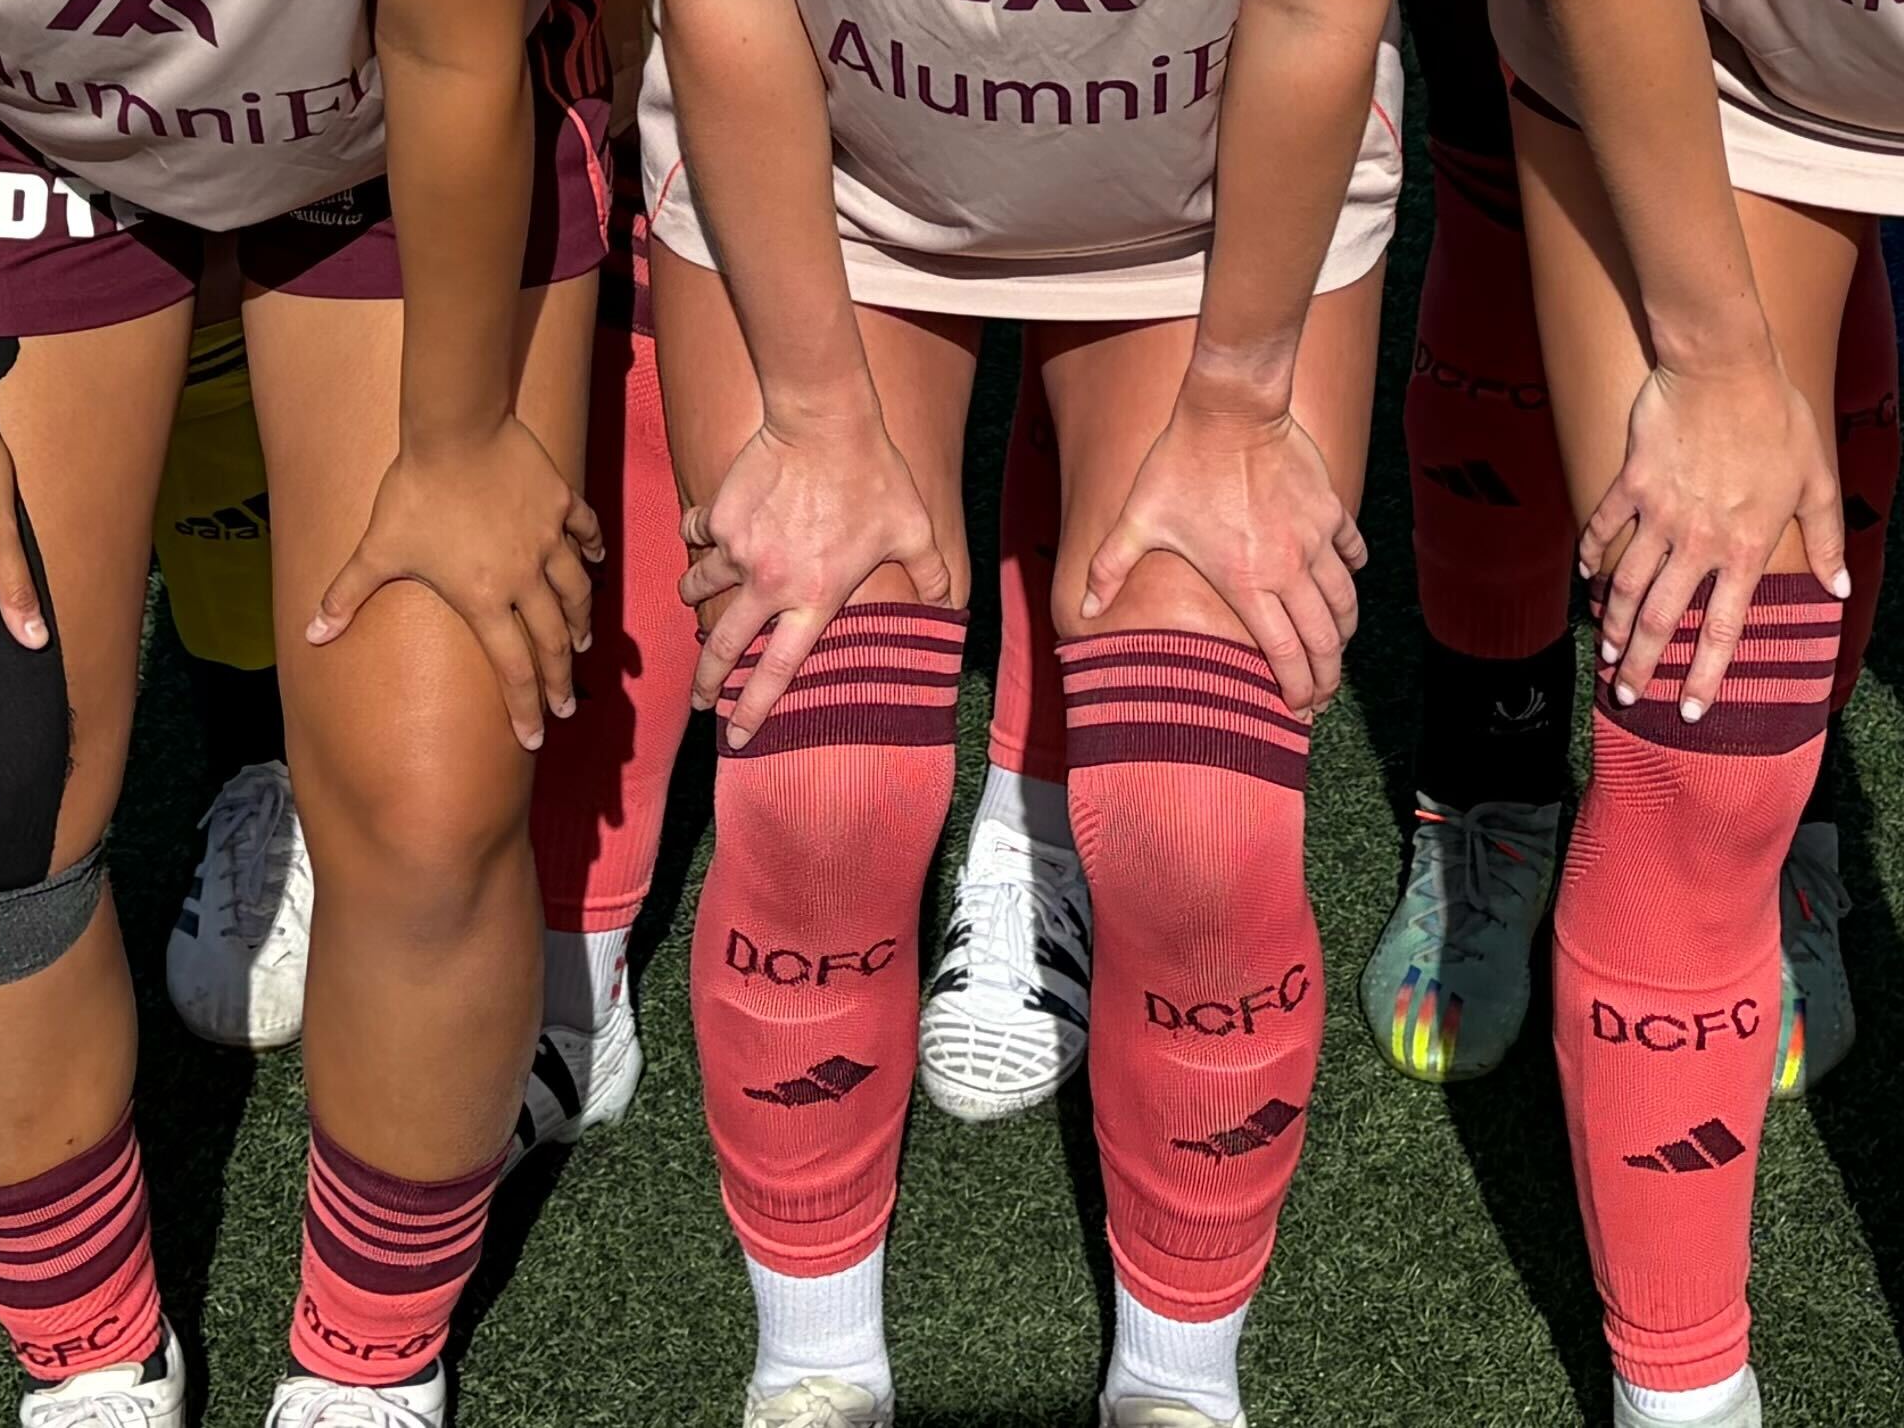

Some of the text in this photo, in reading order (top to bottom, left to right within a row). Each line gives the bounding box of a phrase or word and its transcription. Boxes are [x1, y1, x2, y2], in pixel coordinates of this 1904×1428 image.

[828, 19, 1238, 125] AlumniF
[176, 522, 268, 541] adida
[725, 927, 897, 986] DCFC
[1143, 964, 1312, 1037] DCFC
[1590, 998, 1761, 1053] DCFC
[13, 1316, 126, 1367] CFC
